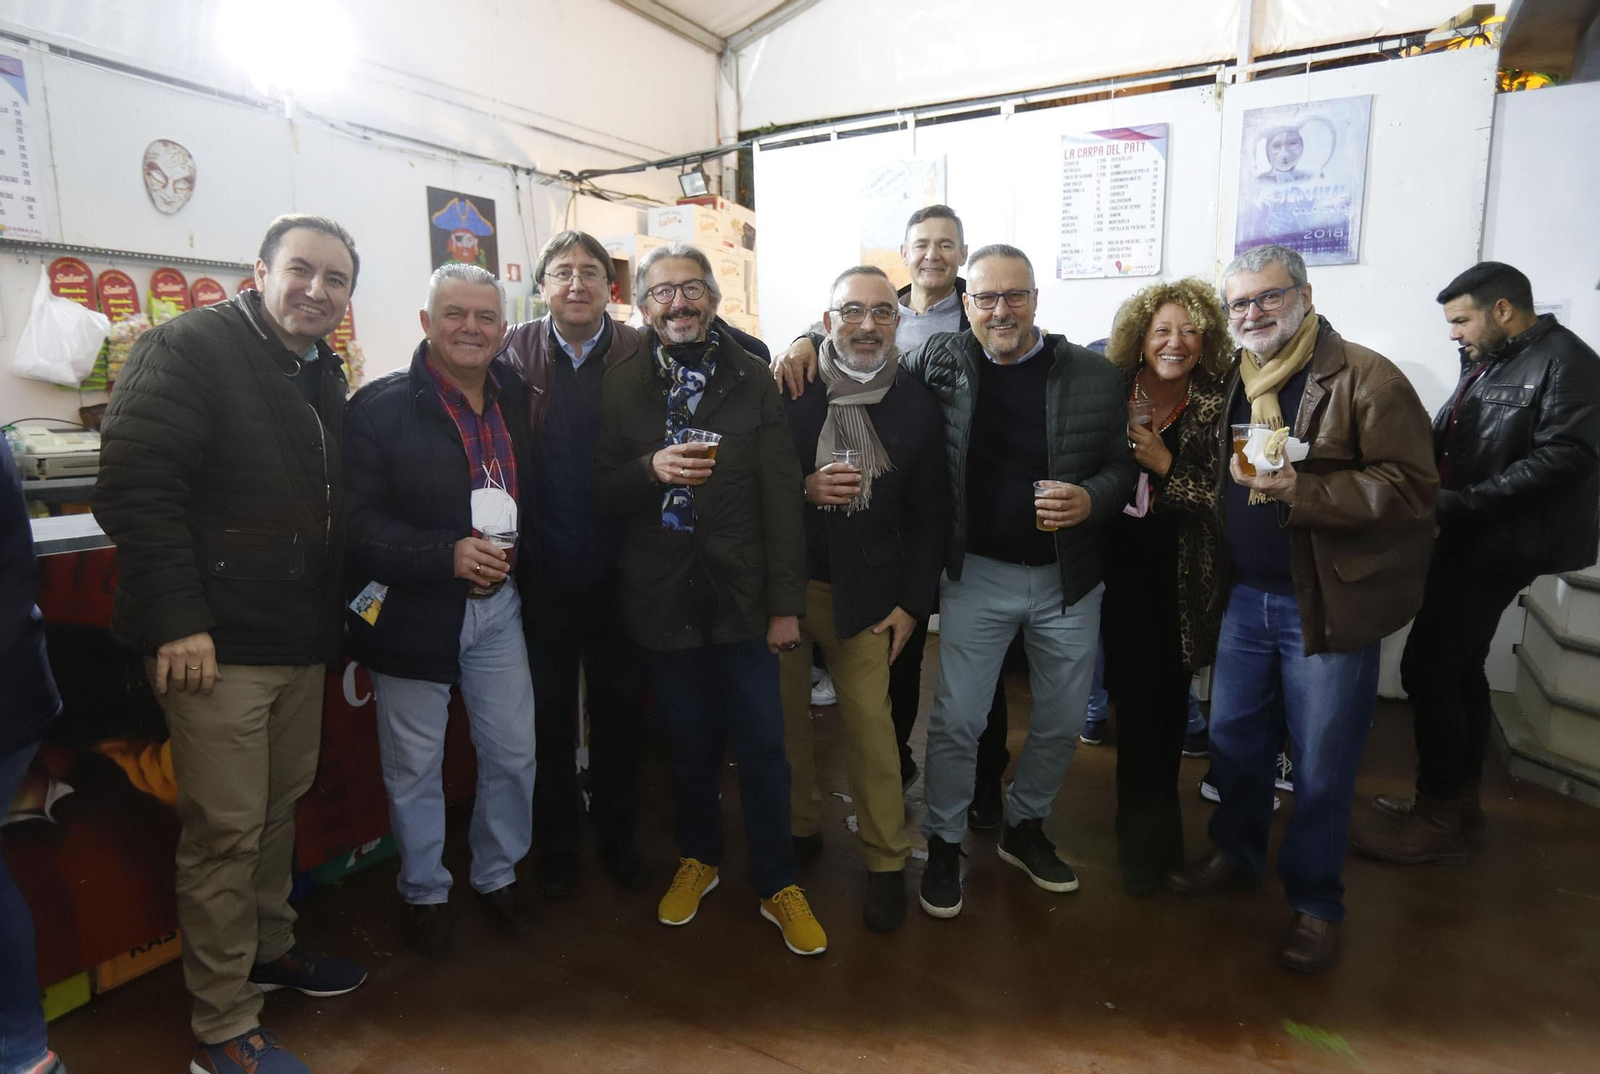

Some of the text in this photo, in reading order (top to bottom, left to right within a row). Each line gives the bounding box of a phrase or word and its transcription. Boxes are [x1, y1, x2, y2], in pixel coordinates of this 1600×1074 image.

[1064, 141, 1146, 160] LA CARPA DEL PATY
[1303, 228, 1344, 239] 2018
